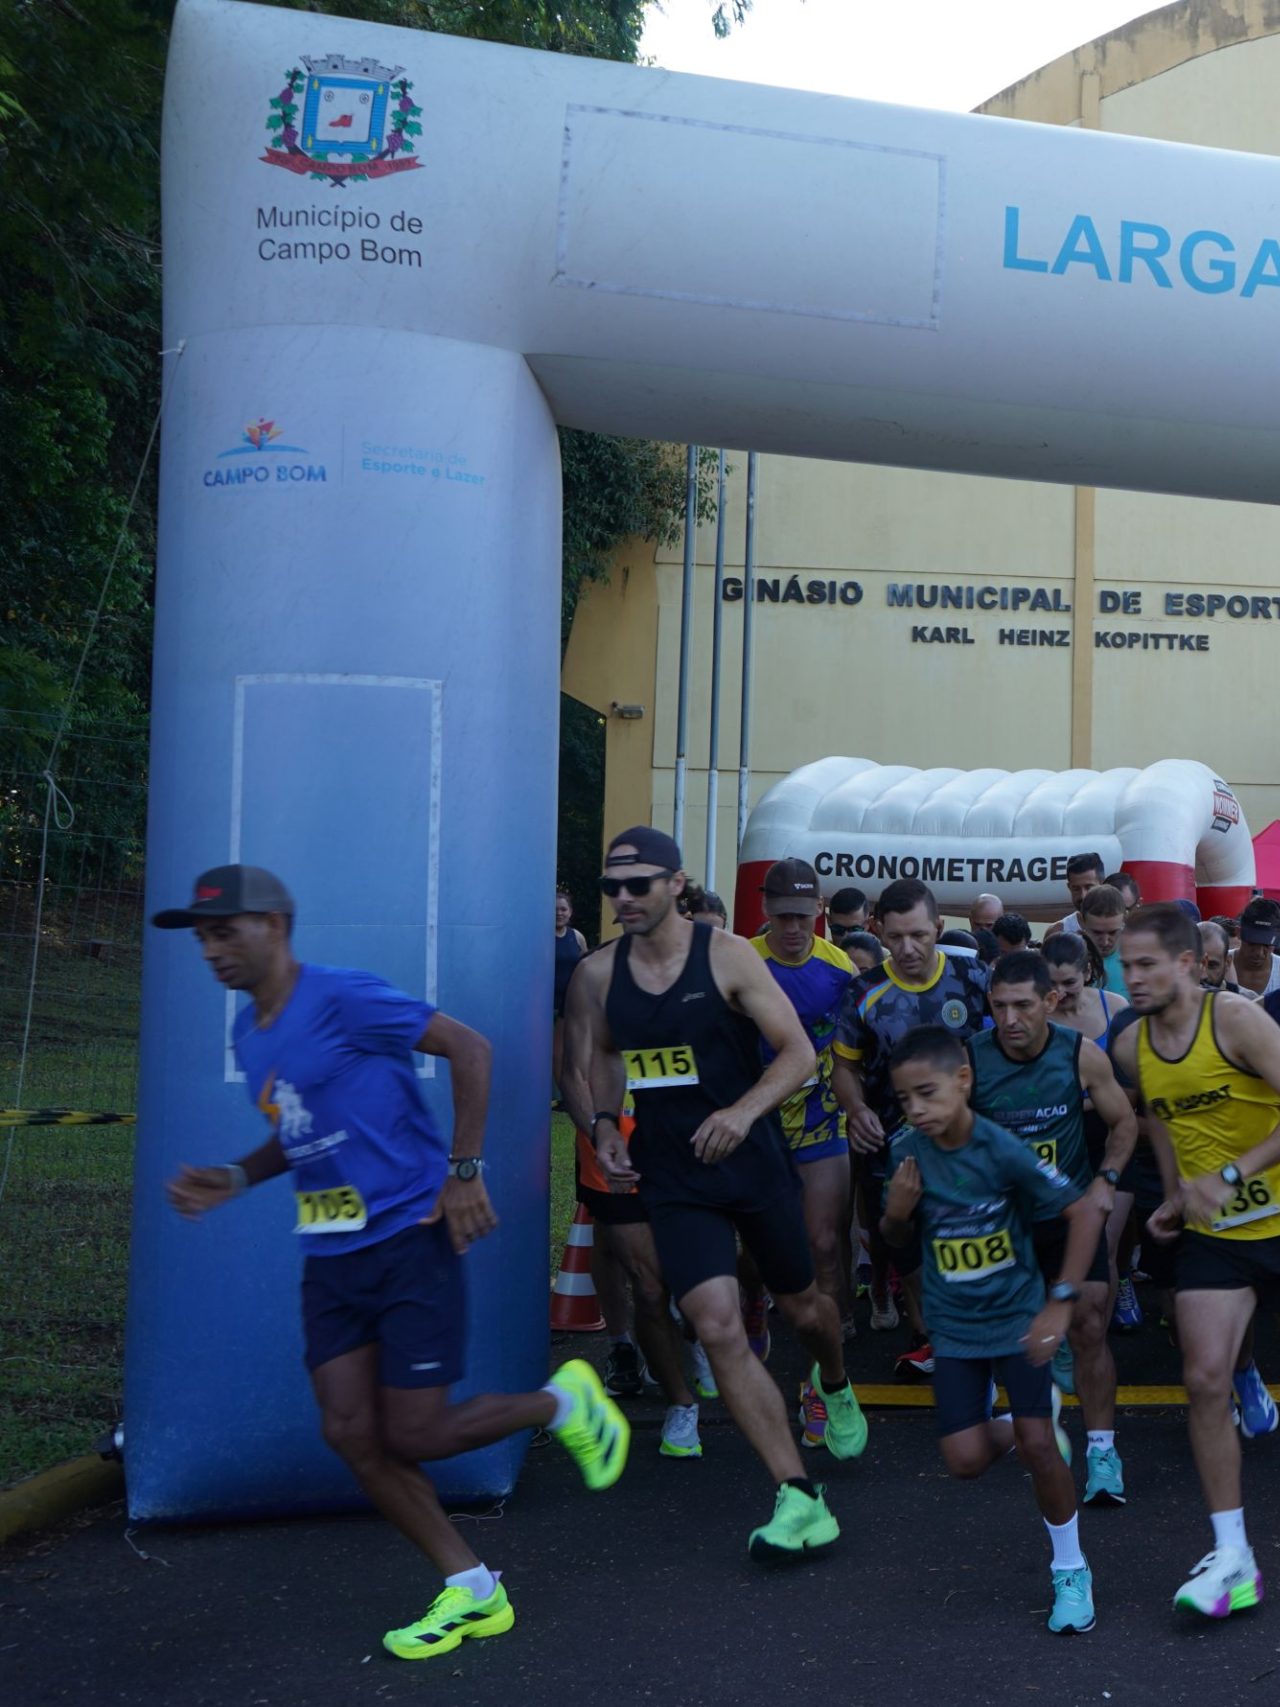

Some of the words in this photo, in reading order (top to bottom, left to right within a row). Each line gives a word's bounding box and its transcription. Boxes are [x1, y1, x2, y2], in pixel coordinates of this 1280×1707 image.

[257, 200, 381, 233] Município
[390, 206, 423, 235] de
[258, 238, 351, 265] Campo
[361, 239, 422, 268] Bom
[203, 466, 270, 487] CAMPO
[277, 465, 328, 483] BOM
[362, 458, 426, 475] Esporte
[432, 467, 441, 478] e
[446, 465, 485, 485] Lazer
[887, 583, 1071, 612] MUNICIPAL
[1100, 590, 1142, 614] DE
[912, 625, 975, 645] KARL
[999, 628, 1070, 647] HEINZ
[1095, 631, 1210, 652] KOPITTKE
[814, 851, 1069, 883] CRONOMETRAGE
[631, 1050, 691, 1078] 115
[939, 1236, 1008, 1272] 008
